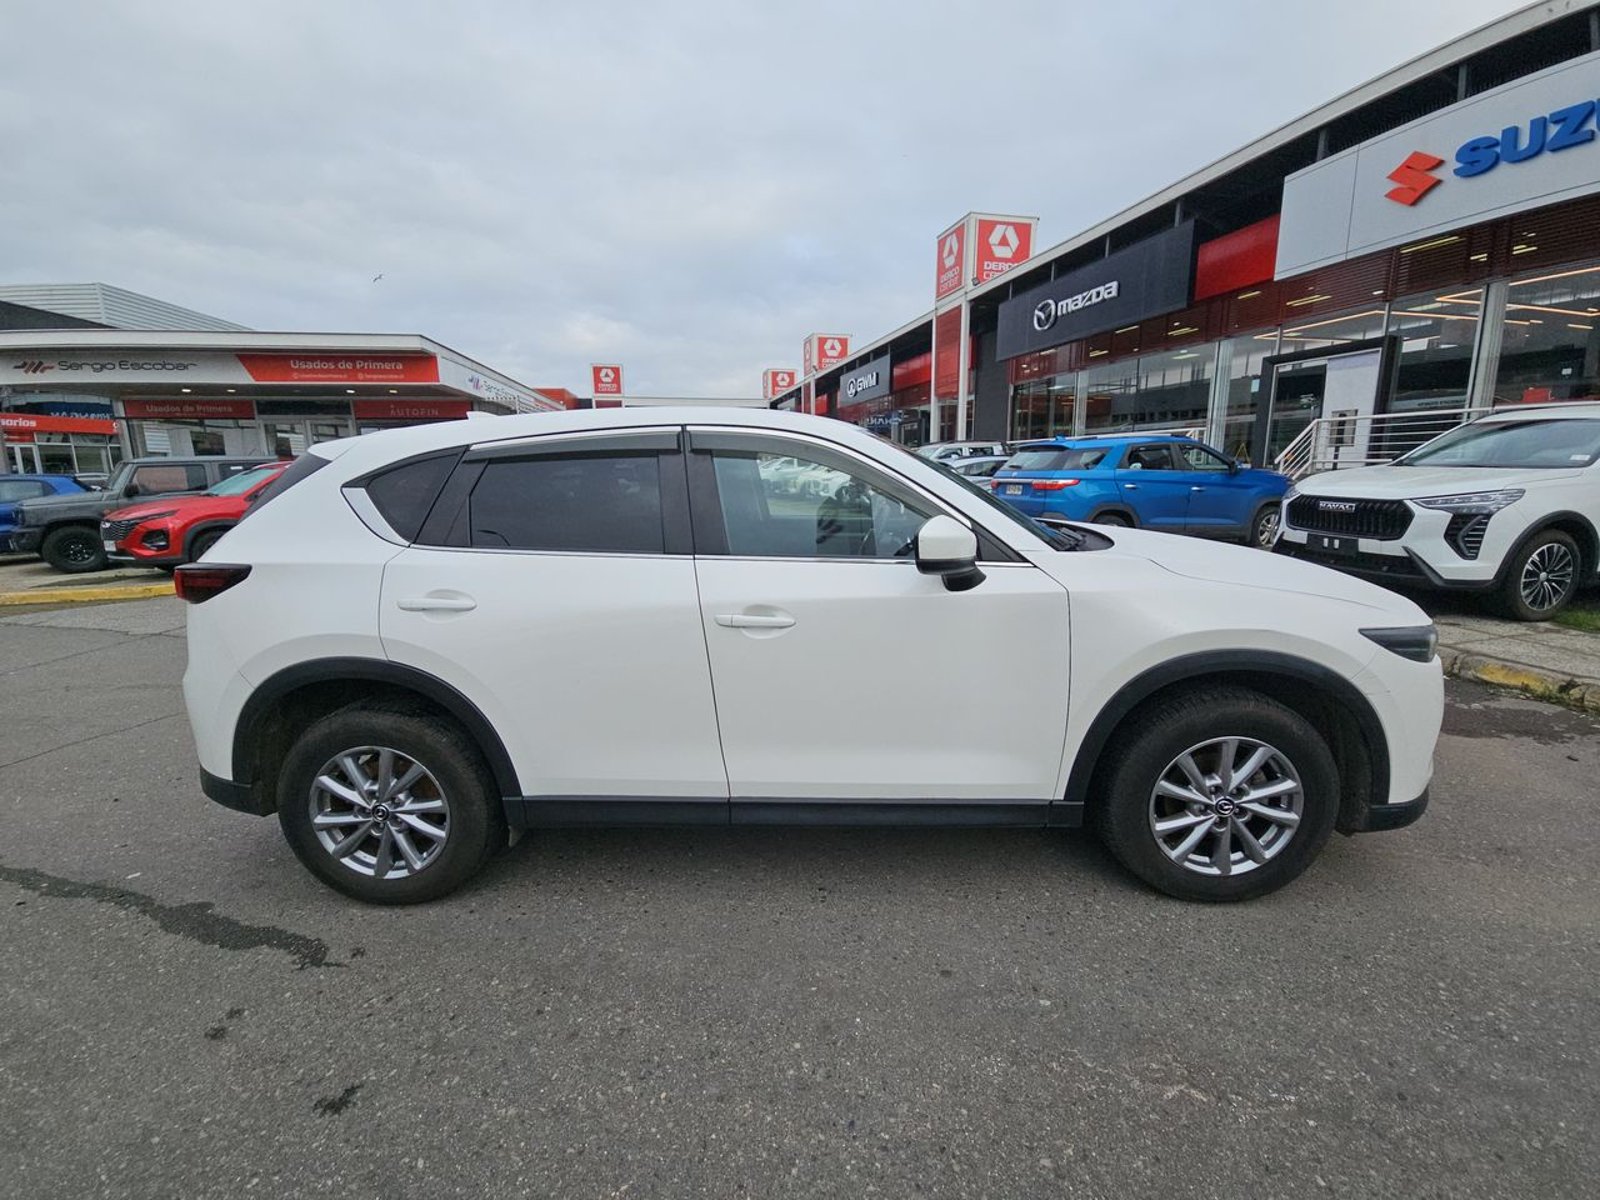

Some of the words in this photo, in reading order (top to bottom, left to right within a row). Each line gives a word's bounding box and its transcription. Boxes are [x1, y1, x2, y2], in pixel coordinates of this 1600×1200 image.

[1453, 98, 1600, 178] SUZ
[1057, 280, 1119, 316] mazda
[118, 359, 198, 371] Escobar
[290, 359, 335, 369] Usados
[338, 359, 353, 369] de
[356, 359, 403, 369] Primera
[146, 404, 181, 412] Usados
[182, 404, 195, 412] de
[196, 404, 233, 413] Primera
[390, 407, 439, 416] AUTOFIN
